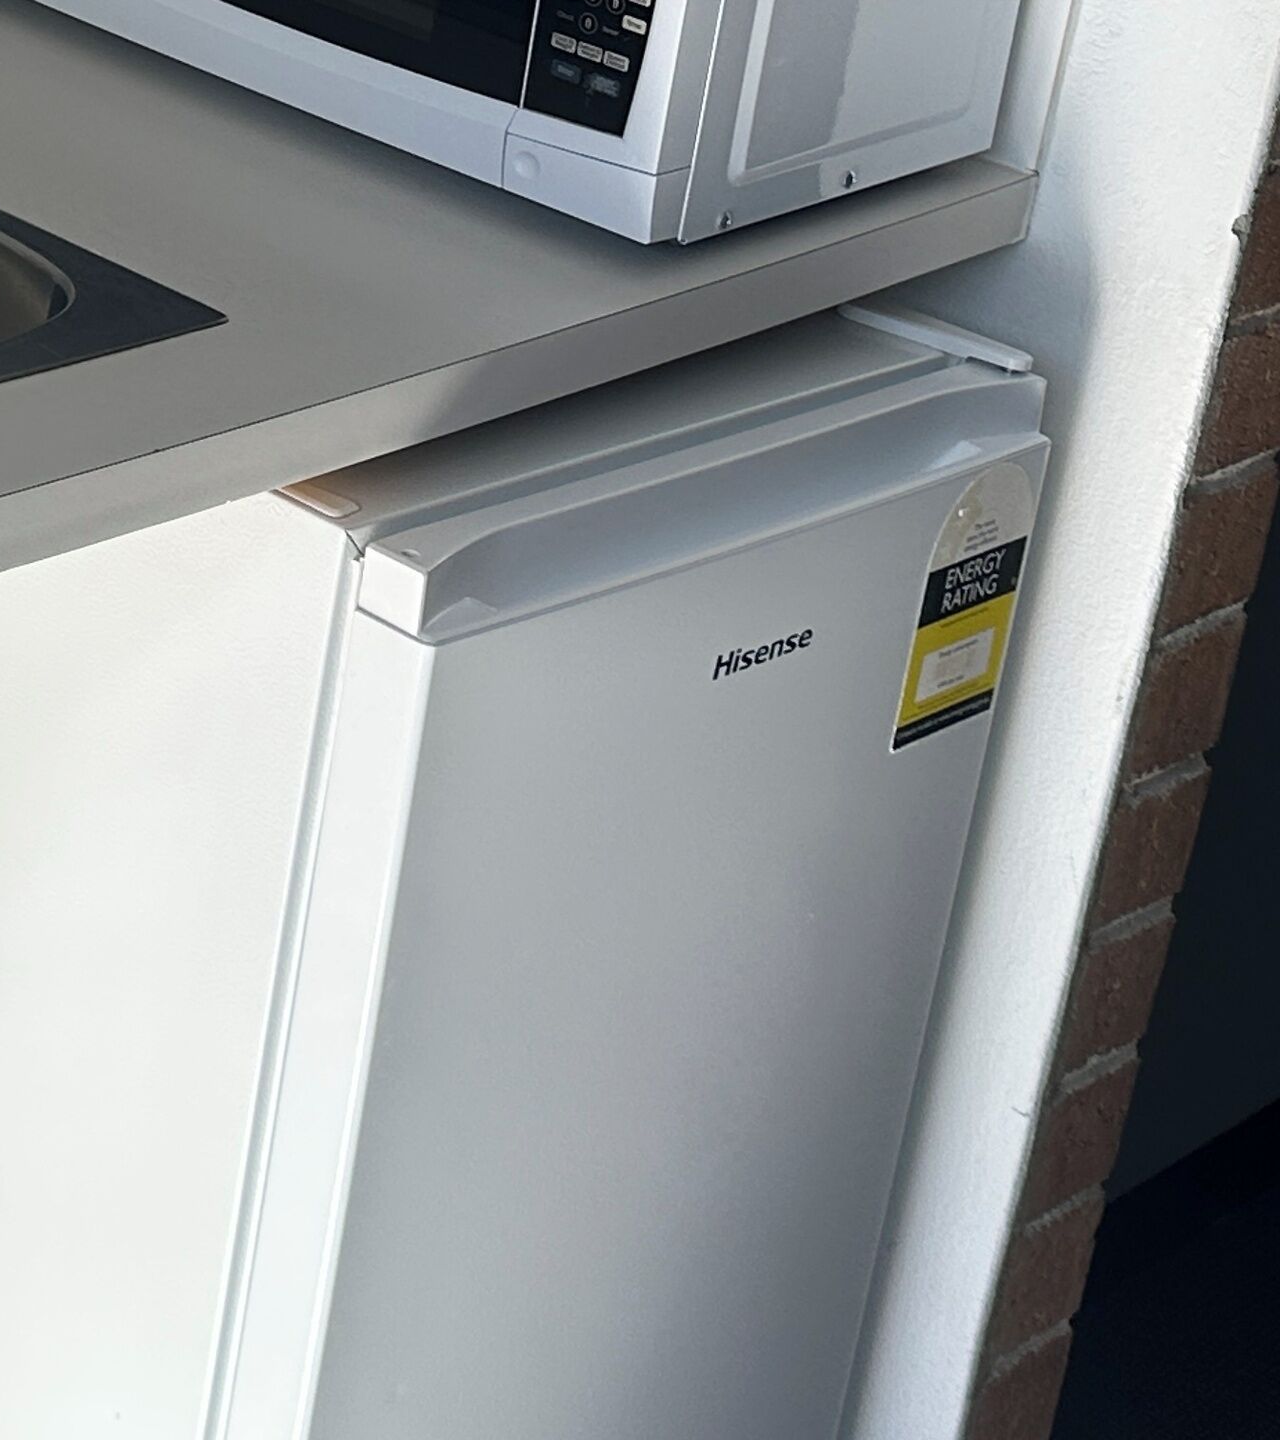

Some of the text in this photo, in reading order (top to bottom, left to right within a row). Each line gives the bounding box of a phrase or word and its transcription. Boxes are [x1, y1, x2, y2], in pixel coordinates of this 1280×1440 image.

[944, 548, 1007, 590] ENERGY
[941, 573, 1000, 614] RATING
[712, 628, 814, 681] Hisense
